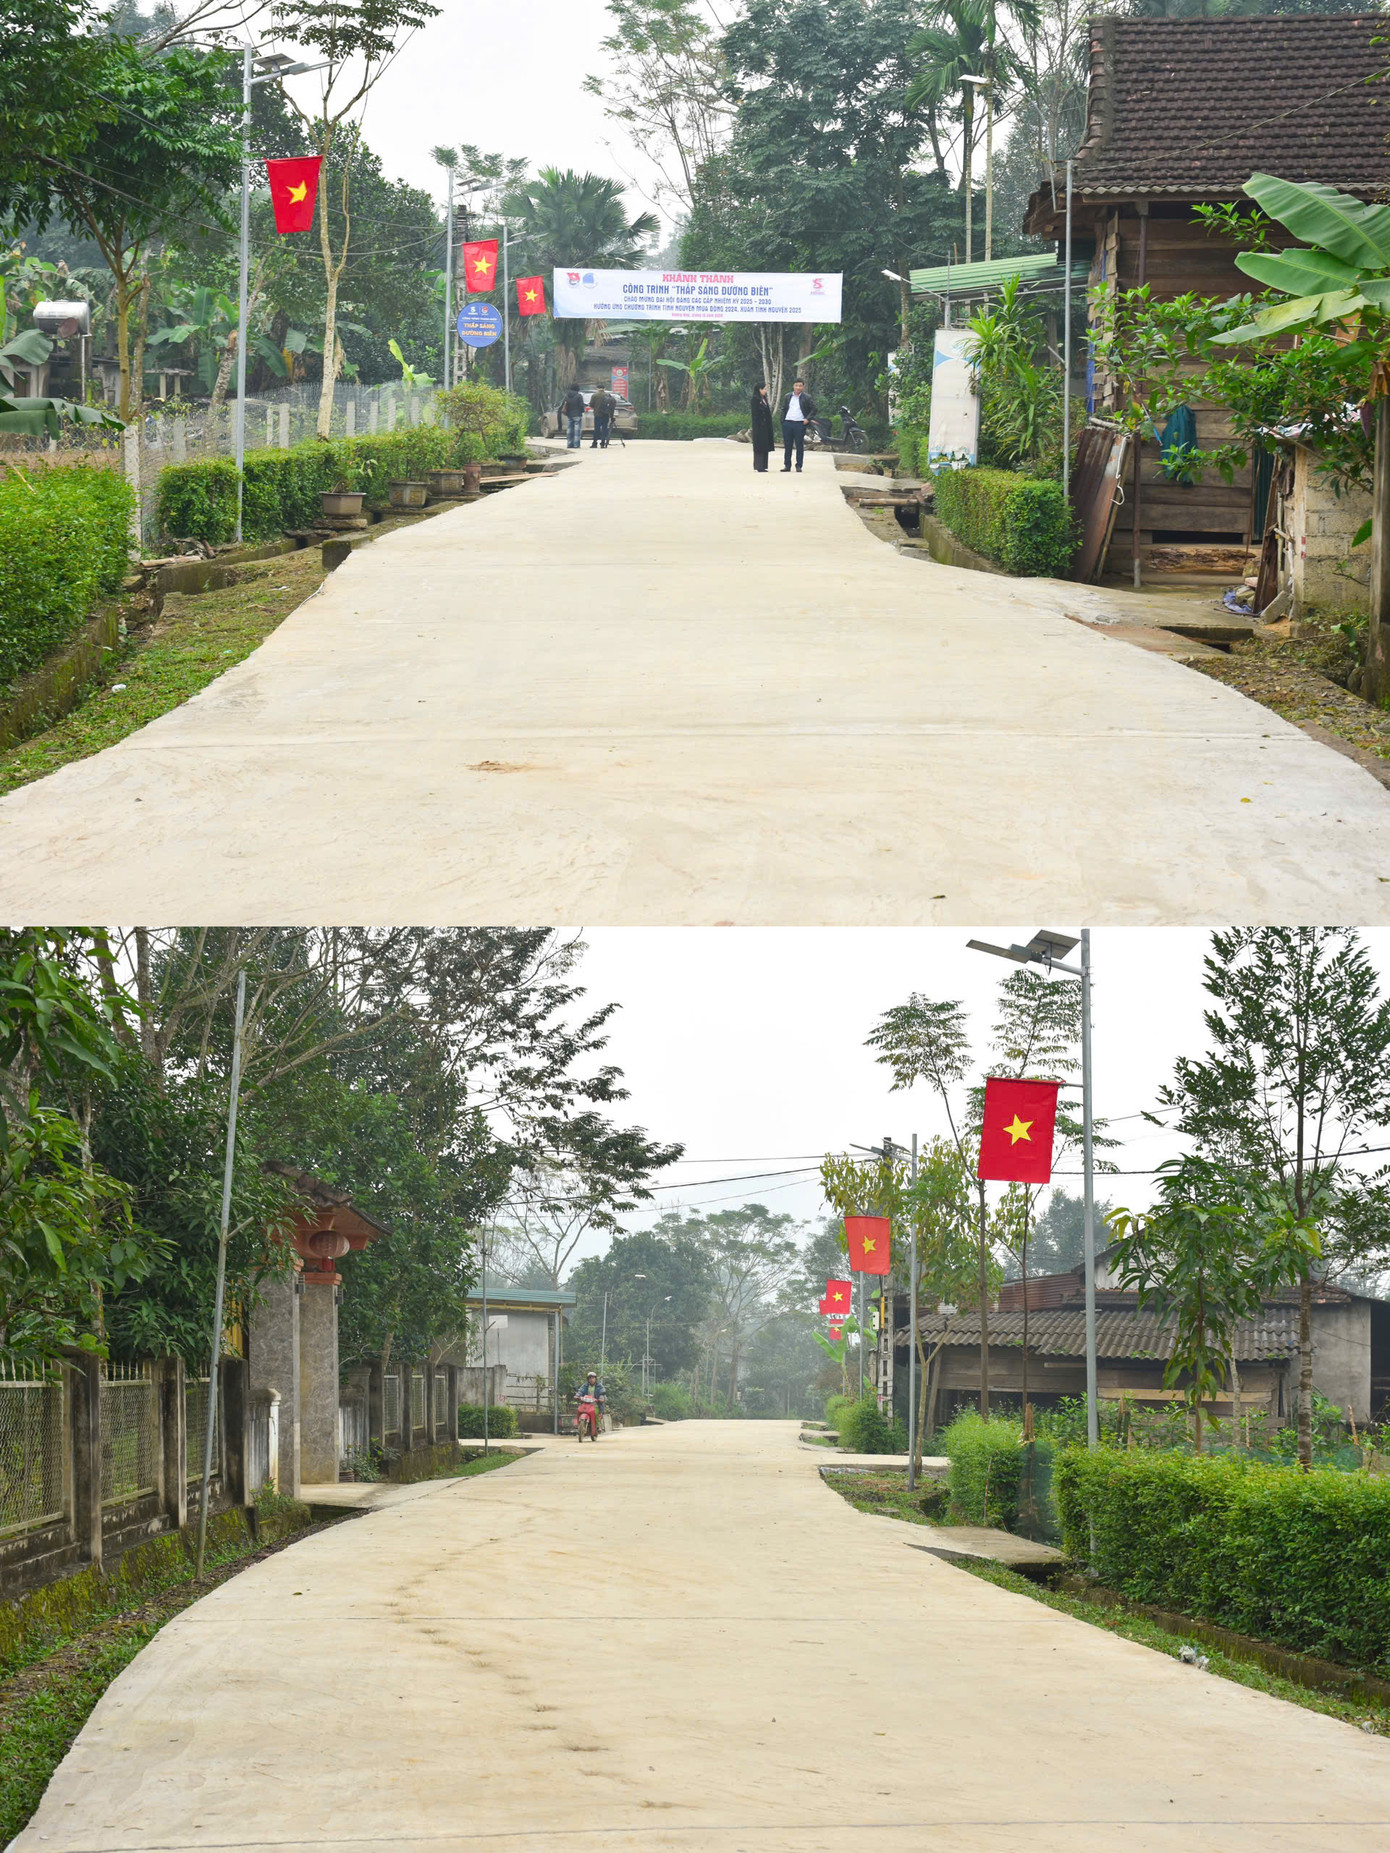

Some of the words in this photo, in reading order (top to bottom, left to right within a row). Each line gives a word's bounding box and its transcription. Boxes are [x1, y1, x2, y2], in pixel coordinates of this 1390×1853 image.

[662, 273, 697, 282] KHÁNH
[700, 274, 734, 283] THÀNH
[623, 283, 643, 293] CÔNG
[647, 284, 669, 294] TRÌNH
[698, 284, 718, 295] SÁNG
[722, 285, 748, 295] ĐƯỜNG
[703, 296, 713, 304] CẤP
